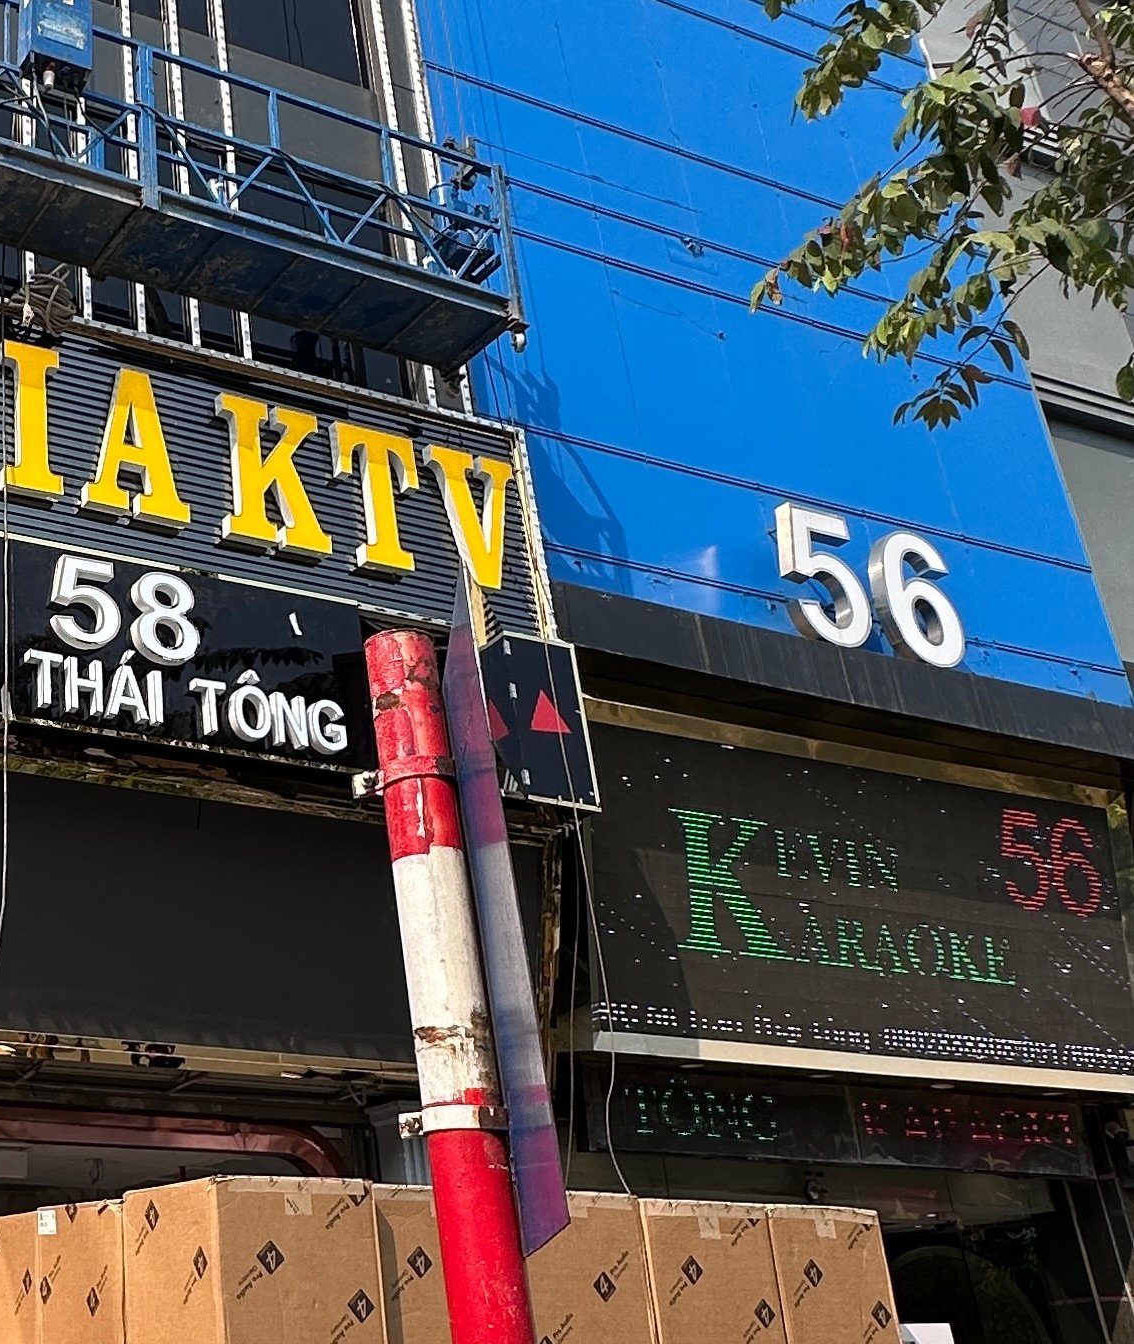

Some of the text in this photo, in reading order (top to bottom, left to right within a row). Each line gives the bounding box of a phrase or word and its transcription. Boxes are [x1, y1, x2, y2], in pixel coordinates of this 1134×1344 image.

[214, 392, 513, 591] KTV
[49, 554, 200, 666] 58
[774, 501, 966, 668] 56
[23, 649, 165, 727] THÁI
[188, 668, 348, 755] TÔNG
[1000, 808, 1103, 919] 56
